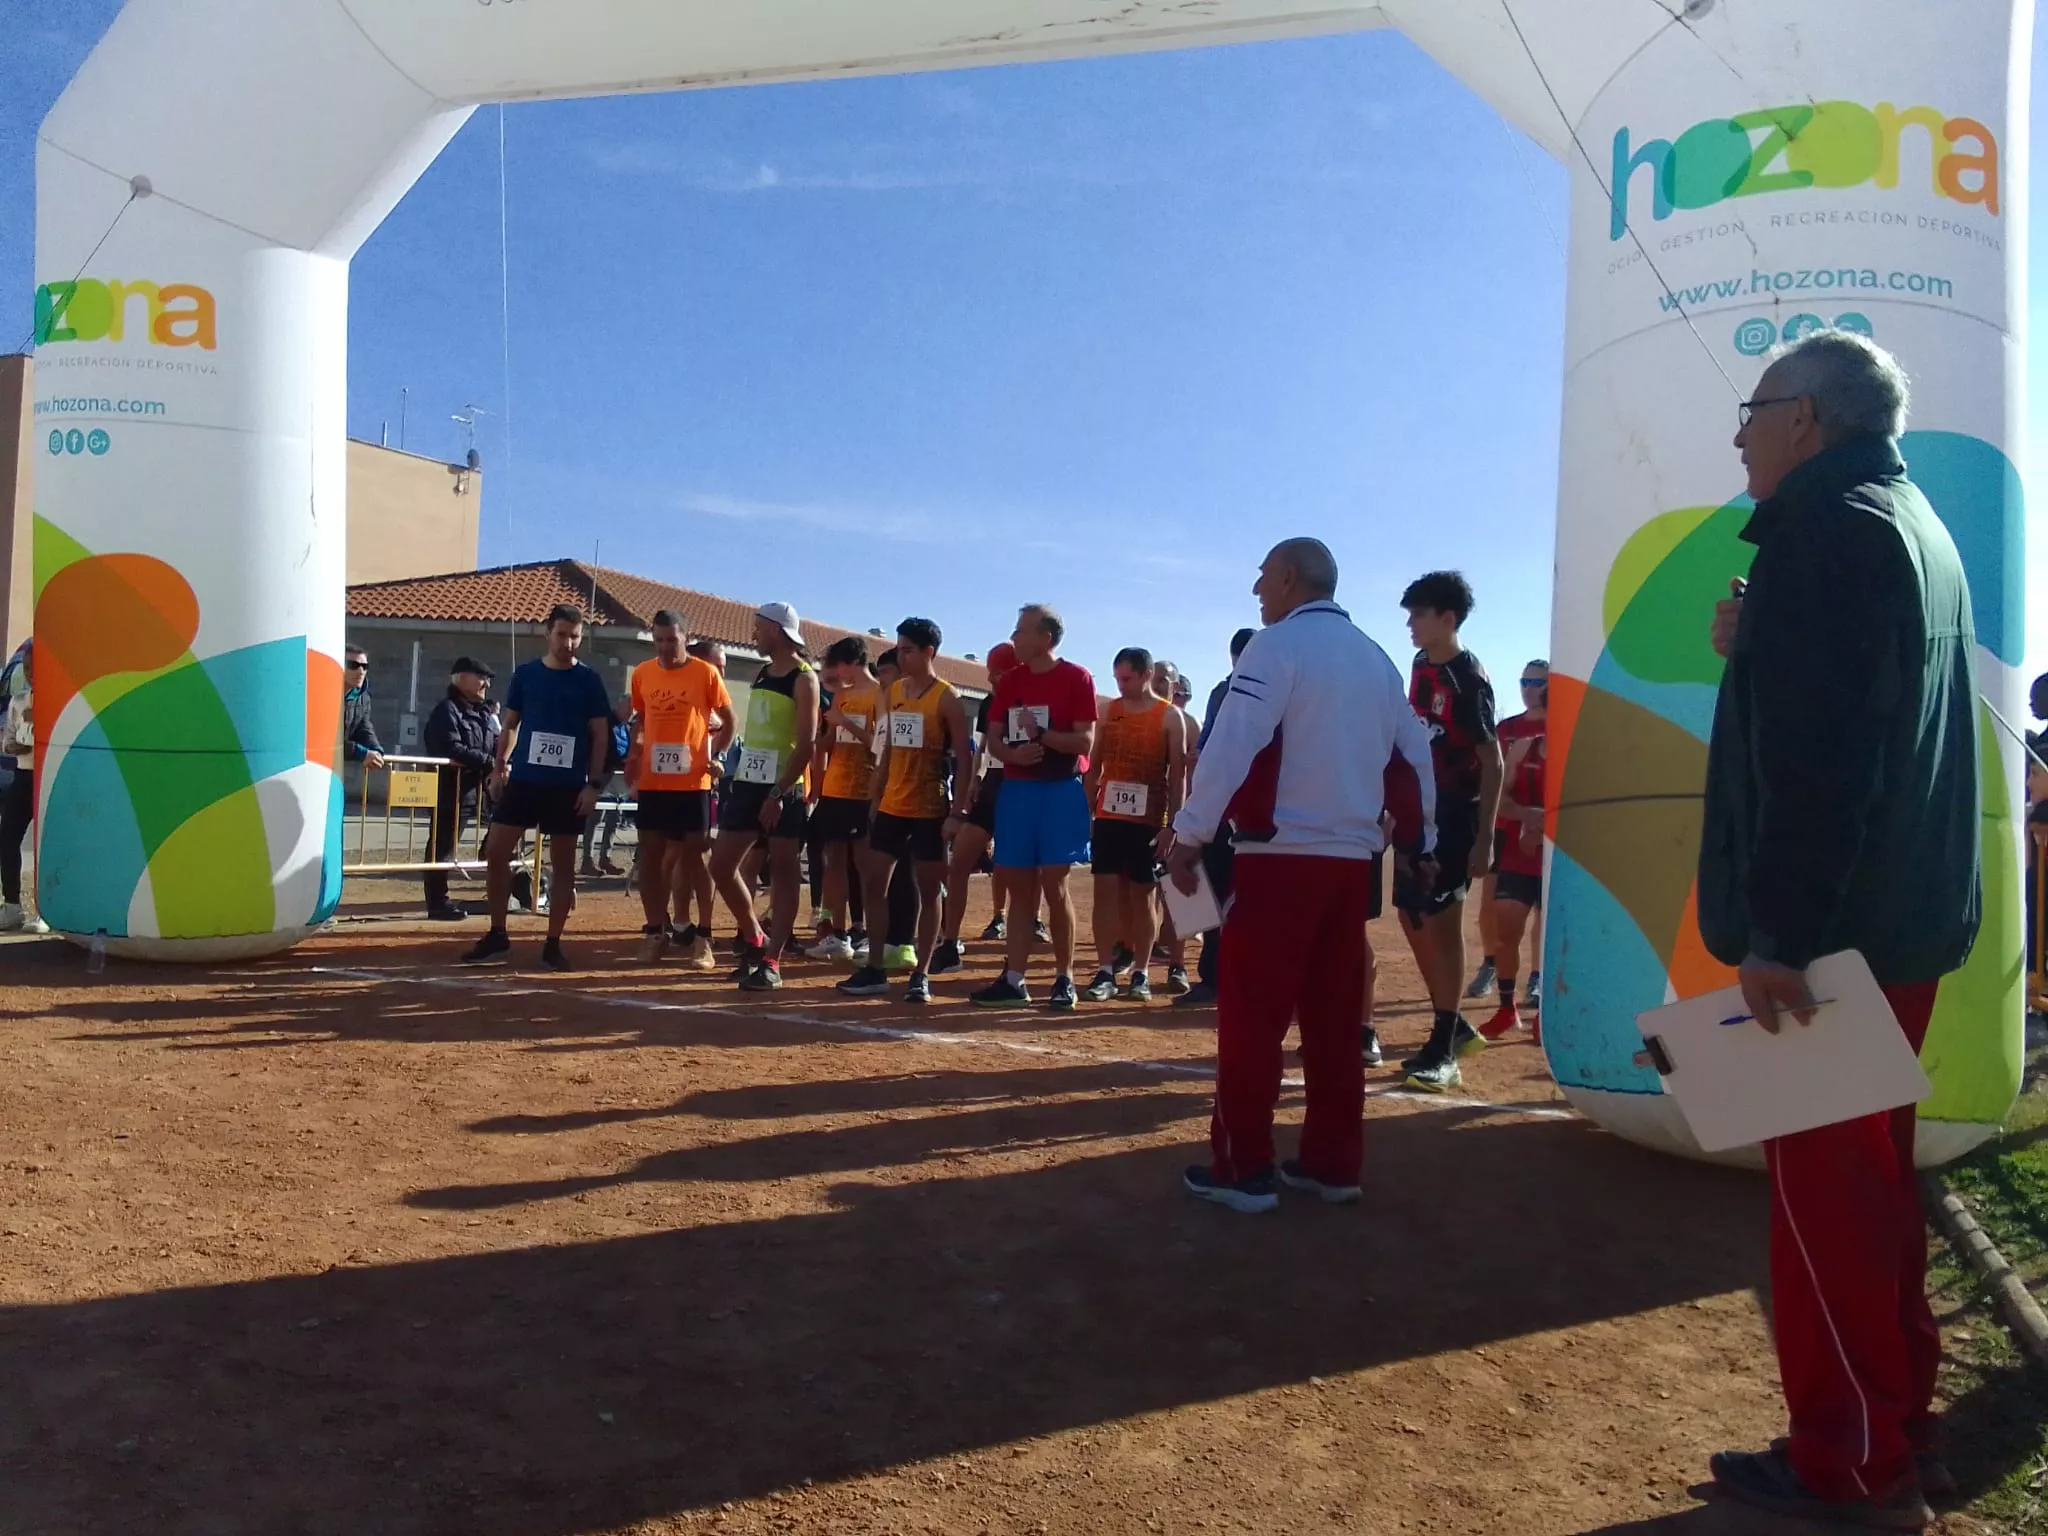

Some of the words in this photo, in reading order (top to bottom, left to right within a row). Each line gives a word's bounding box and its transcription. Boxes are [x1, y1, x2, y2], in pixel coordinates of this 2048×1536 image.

[1610, 100, 1999, 242] hozona
[1607, 250, 1642, 275] OCIO
[1660, 220, 1745, 253] GESTION
[1769, 210, 1908, 228] RECREACION
[1658, 268, 1954, 313] www.hozona.com
[136, 358, 218, 376] DEPORTIVA
[895, 723, 913, 735] 292
[540, 743, 563, 756] 280
[658, 752, 680, 764] 279
[746, 757, 766, 771] 257
[1115, 791, 1136, 805] 194
